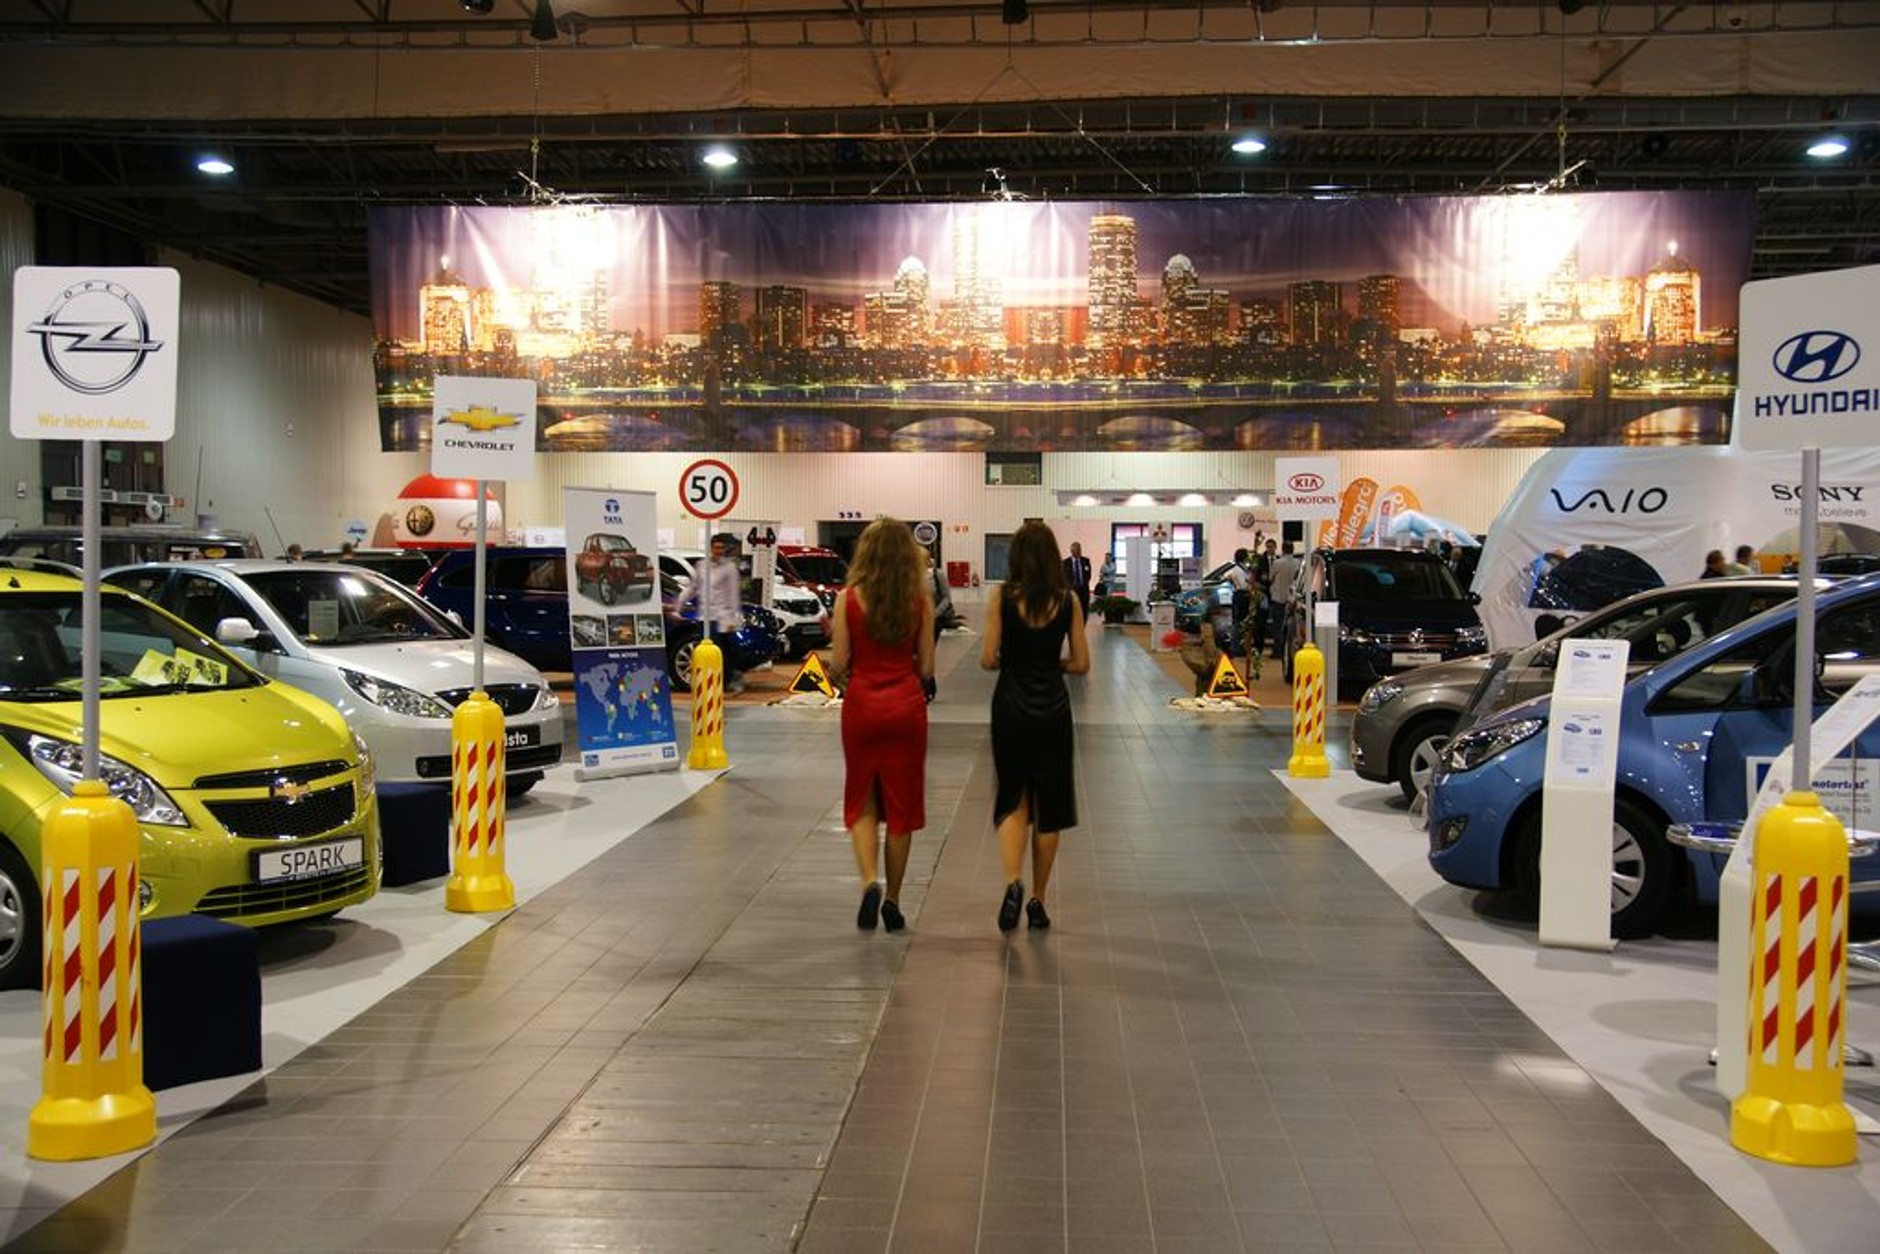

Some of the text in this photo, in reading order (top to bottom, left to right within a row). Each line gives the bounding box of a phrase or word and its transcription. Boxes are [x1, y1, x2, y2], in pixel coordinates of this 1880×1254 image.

[1755, 389, 1879, 417] HYUNDAI
[36, 413, 59, 428] Wir
[444, 439, 515, 451] CHEVROLET
[690, 475, 728, 503] 50
[1294, 477, 1318, 488] KIA
[1276, 496, 1336, 505] KIA MOTORS
[1549, 486, 1669, 514] VAIO
[281, 845, 344, 875] SPARK
